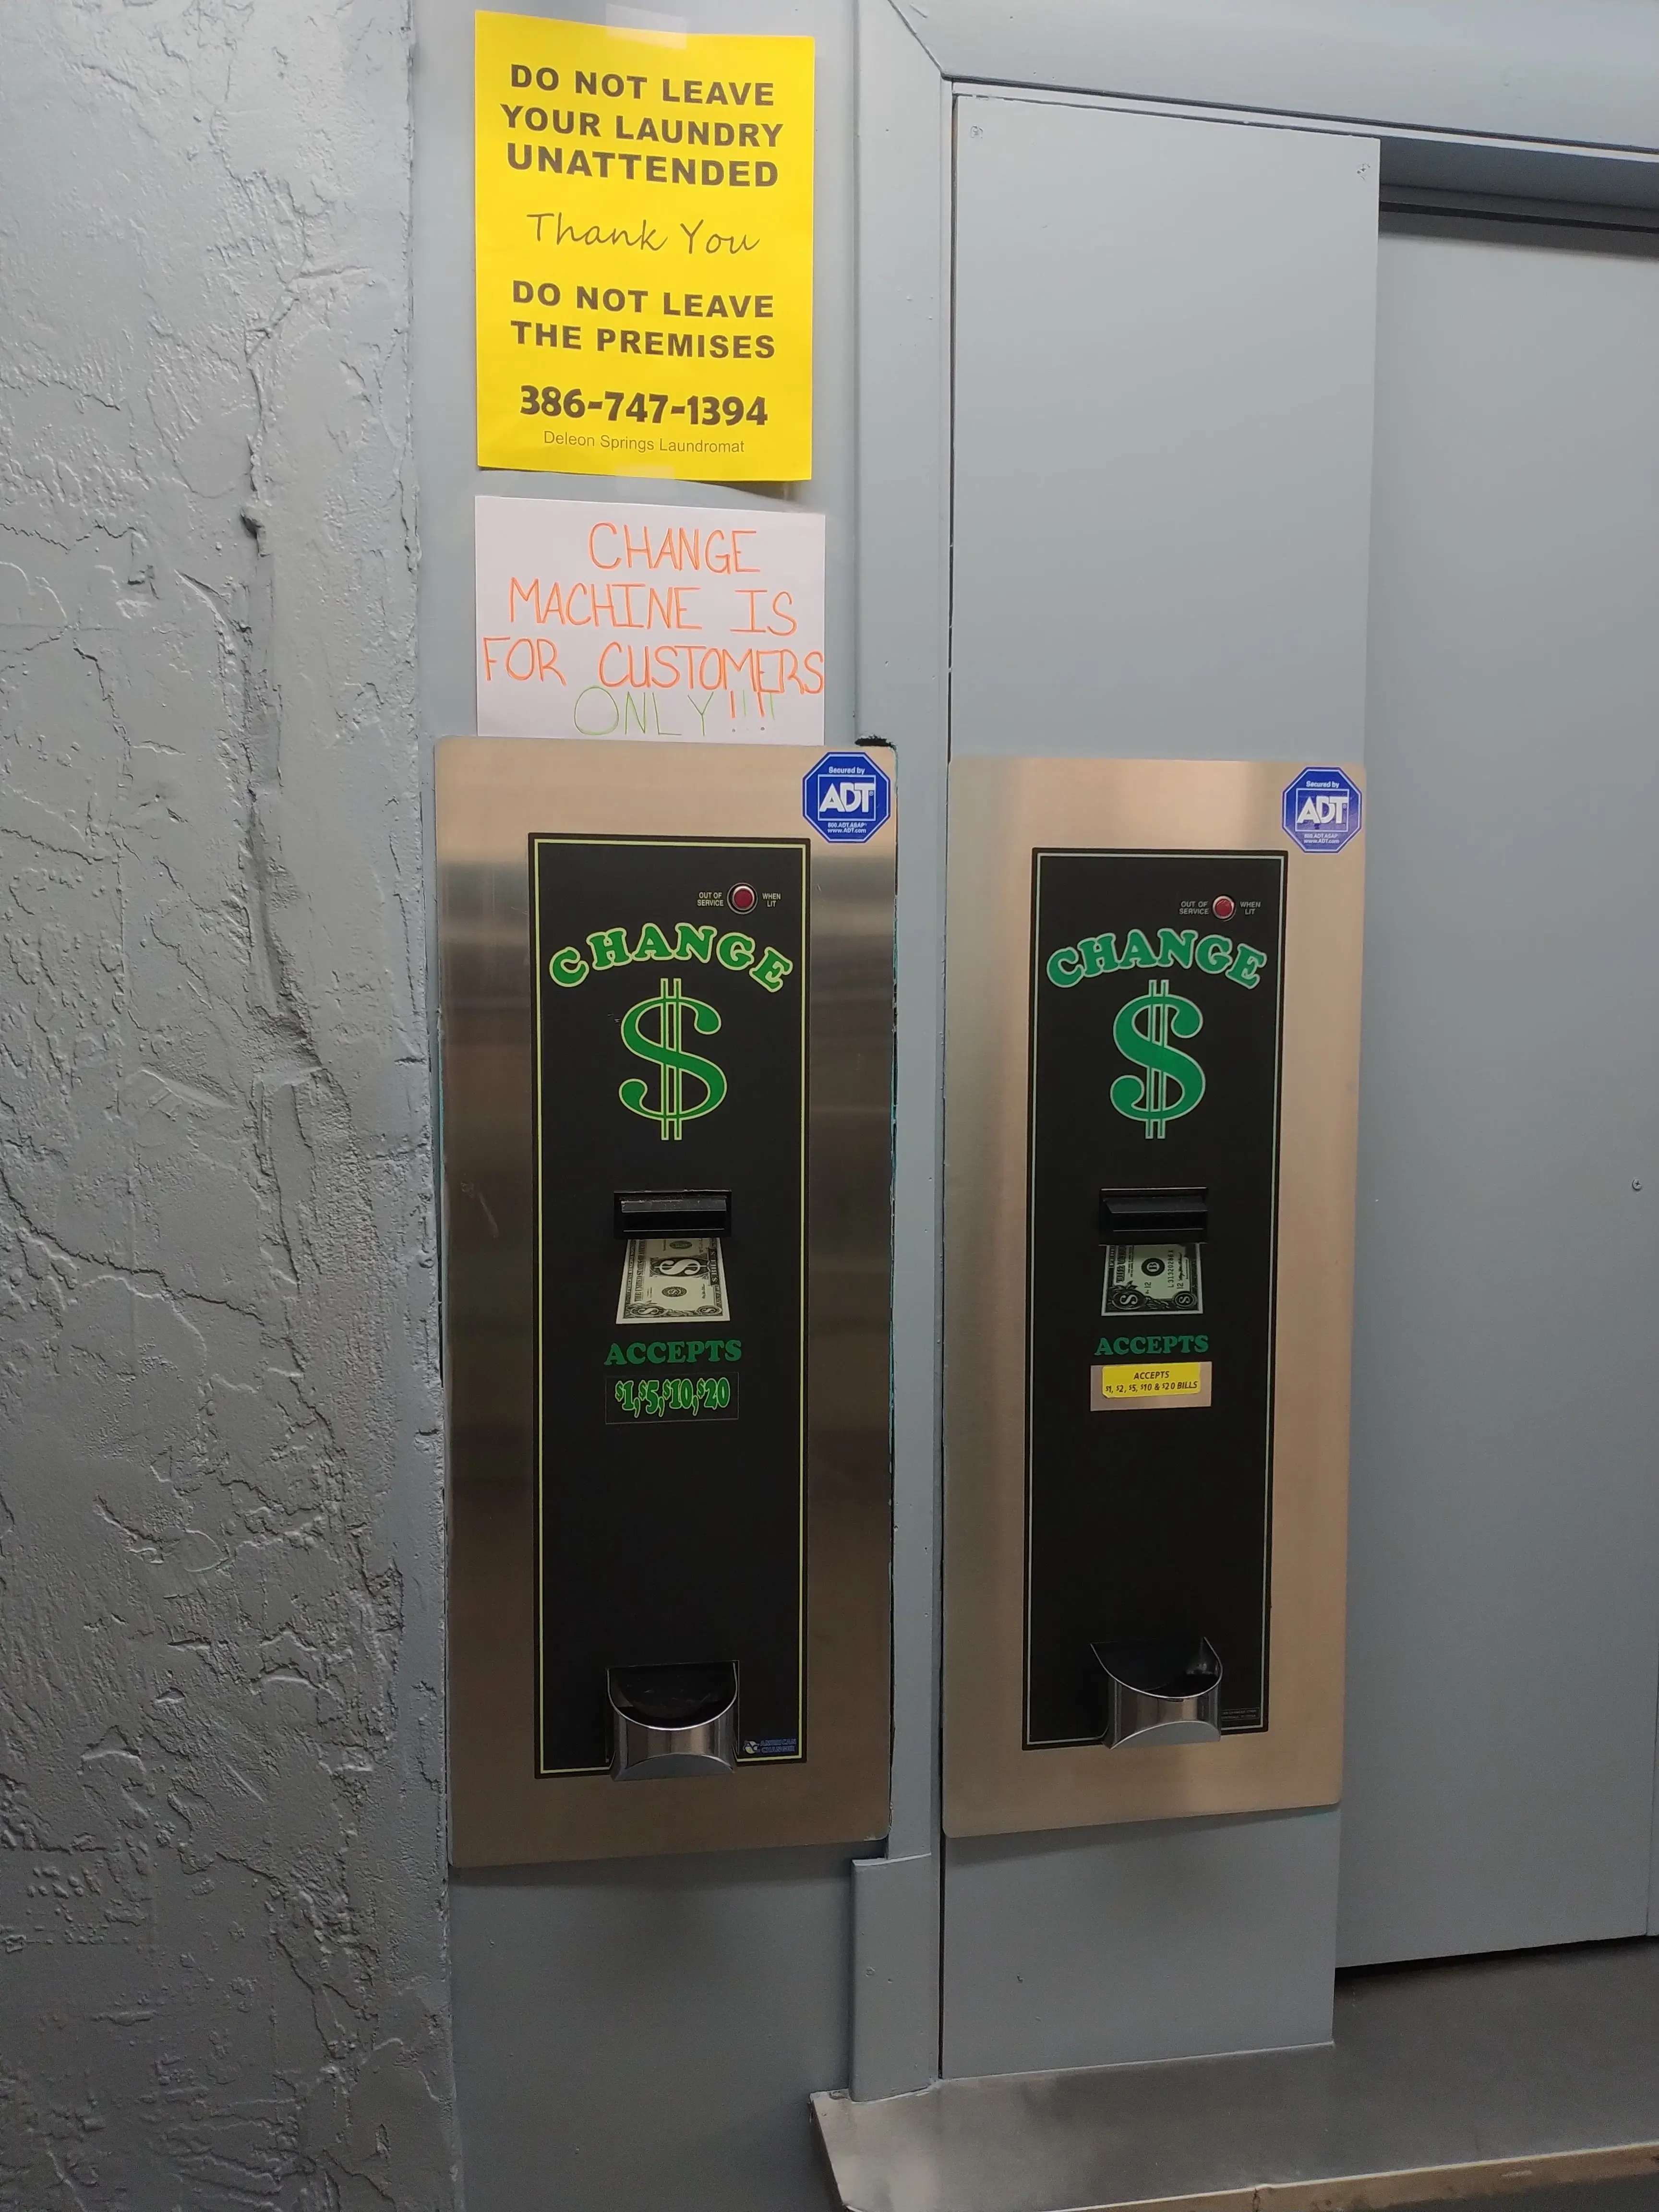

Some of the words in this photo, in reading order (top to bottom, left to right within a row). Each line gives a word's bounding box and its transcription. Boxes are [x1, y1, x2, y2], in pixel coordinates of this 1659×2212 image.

[511, 64, 559, 90] DO
[576, 71, 647, 99] NOT
[663, 79, 774, 106] LEAVE
[500, 104, 601, 137] YOUR
[616, 115, 784, 147] LAUNDRY
[507, 143, 778, 187] UNATTENDED
[527, 212, 668, 251] Thank
[680, 219, 760, 254] You
[513, 280, 560, 306] DO
[577, 286, 648, 313] NOT
[664, 292, 774, 318] LEAVE
[511, 321, 581, 350] THE
[597, 328, 775, 359] PREMISES
[520, 385, 768, 426] 386-747-1394
[544, 431, 595, 447] Deleon
[600, 435, 654, 453] Springs
[660, 438, 745, 452] Laundromat
[589, 522, 760, 574] CHANGE
[510, 577, 702, 630] MACHINE
[730, 589, 797, 636] IS
[483, 637, 566, 686] FOR
[599, 641, 824, 695] CUSTOMERS
[819, 782, 875, 813] ADT
[1297, 795, 1348, 824] ADT
[550, 923, 793, 993] CHANGE
[1046, 928, 1267, 989] CHANGE
[619, 978, 727, 1141] $
[1110, 979, 1206, 1139] $
[603, 1339, 742, 1365] ACCEPTS
[1094, 1335, 1209, 1356] ACCEPTS
[1116, 1385, 1127, 1393] $2,
[1129, 1384, 1138, 1393] $5,
[1177, 1381, 1199, 1389] BILLS
[1133, 1370, 1170, 1380] ACCEPTS
